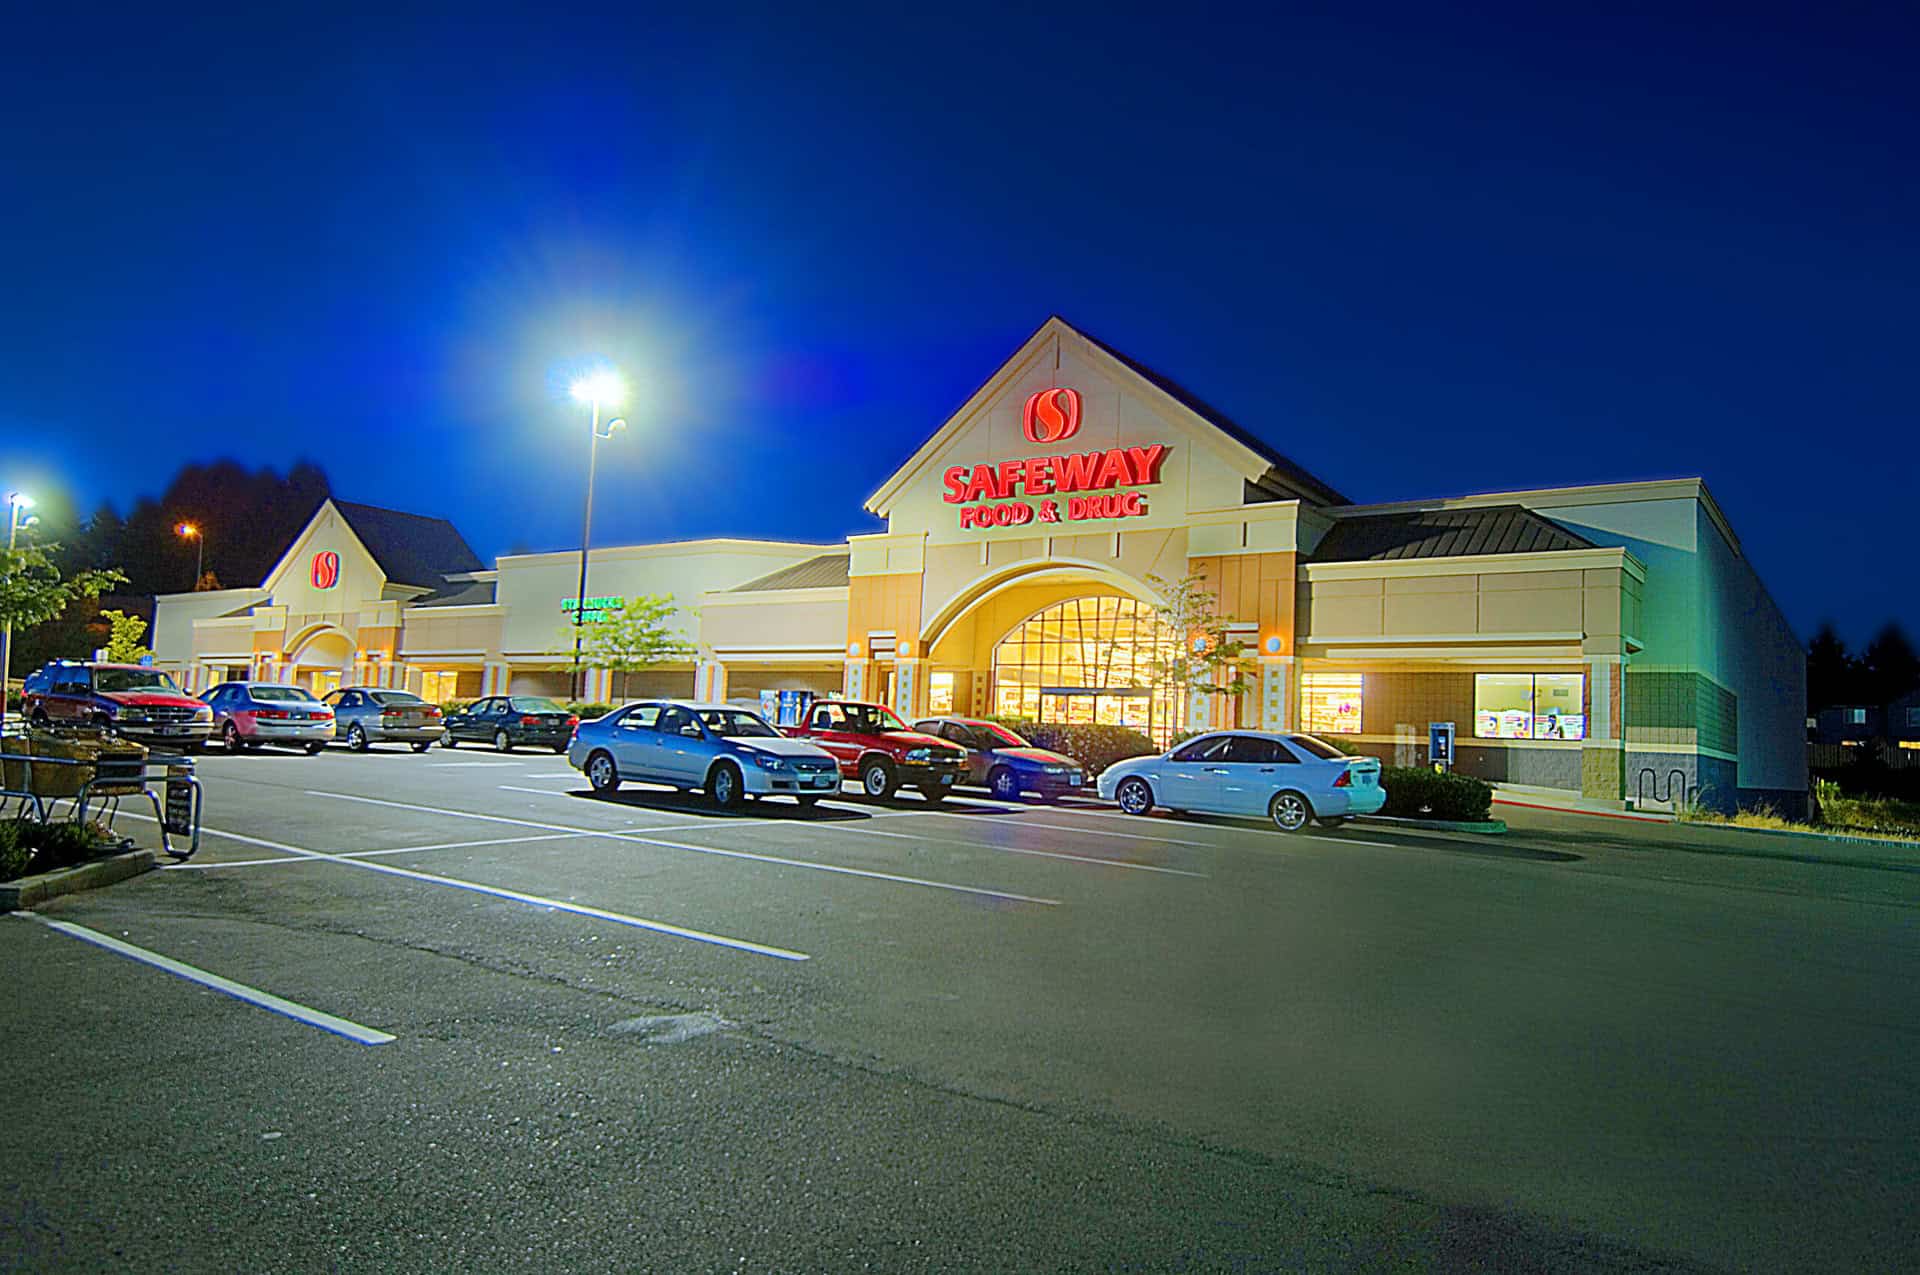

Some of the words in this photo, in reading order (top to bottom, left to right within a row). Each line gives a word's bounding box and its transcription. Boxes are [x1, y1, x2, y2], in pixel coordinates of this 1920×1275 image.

[943, 444, 1163, 504] SAFEWAY
[960, 502, 1033, 528] FOOD
[1038, 501, 1060, 522] &
[1068, 492, 1147, 520] DRUG
